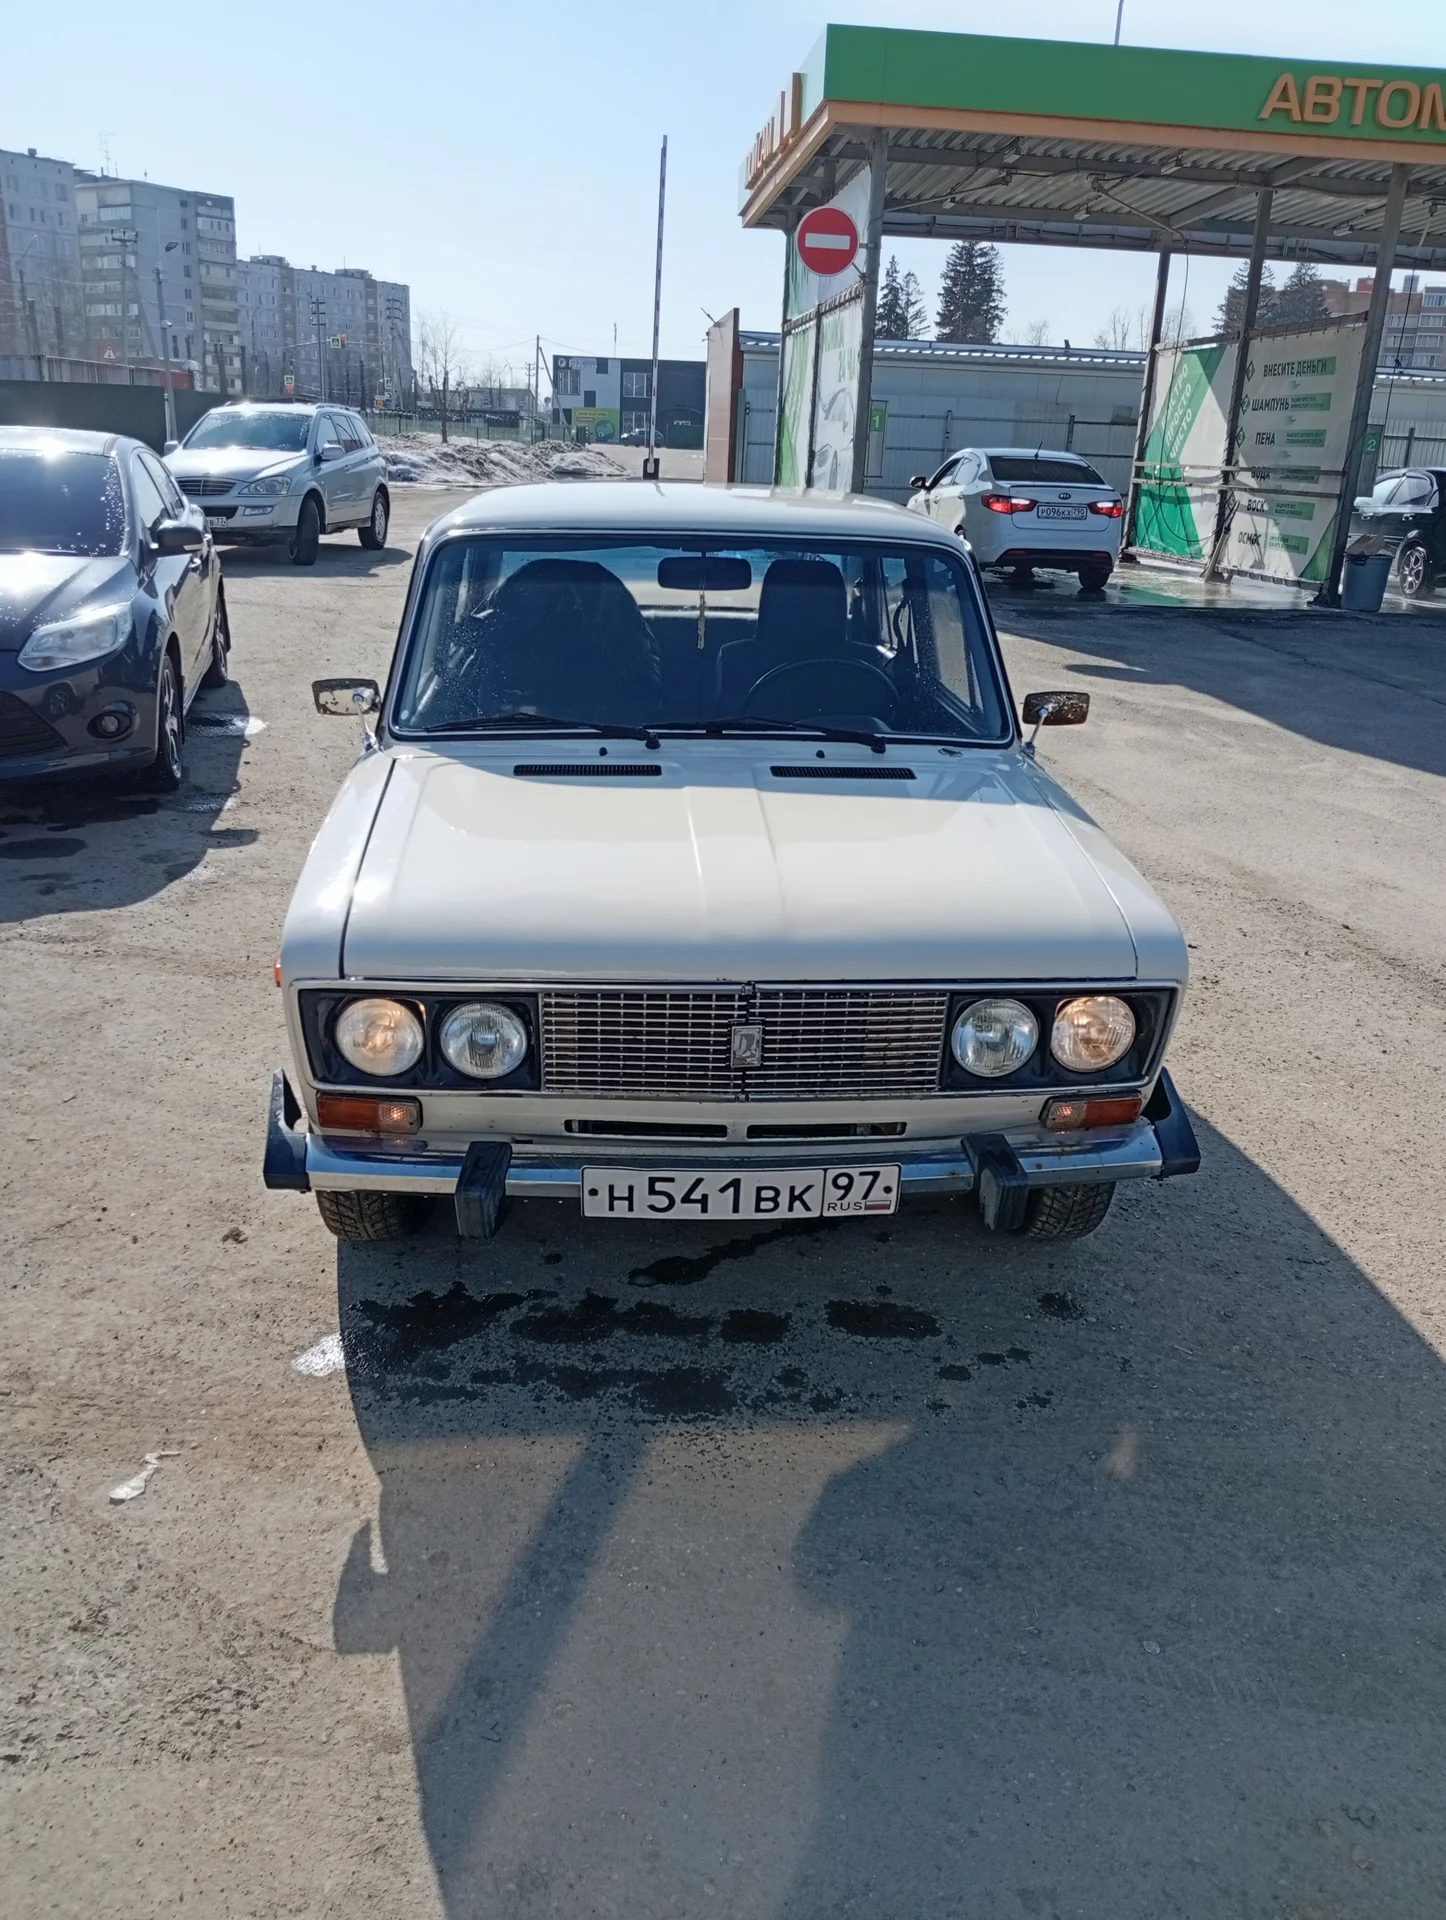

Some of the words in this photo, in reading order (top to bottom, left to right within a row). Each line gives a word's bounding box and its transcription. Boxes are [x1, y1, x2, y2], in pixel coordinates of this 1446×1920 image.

[1262, 362, 1295, 377] ВНЕСИТЕ
[1296, 359, 1327, 377] ДЕНЬГИ
[1251, 397, 1290, 412] ШАМПУНЬ
[872, 415, 880, 429] 1
[1165, 383, 1192, 447] ПРОСТО
[1169, 408, 1192, 459] ЧИСТО
[1255, 432, 1276, 445] ПЕНА
[1366, 438, 1377, 452] 2
[1041, 507, 1072, 517] Р096КХ
[1073, 507, 1085, 515] 790
[1246, 499, 1267, 513] ВОСК
[1237, 531, 1262, 546] ОСМОС
[607, 1176, 815, 1214] Н541ВК
[831, 1171, 881, 1201] 97
[827, 1202, 863, 1212] RUS
